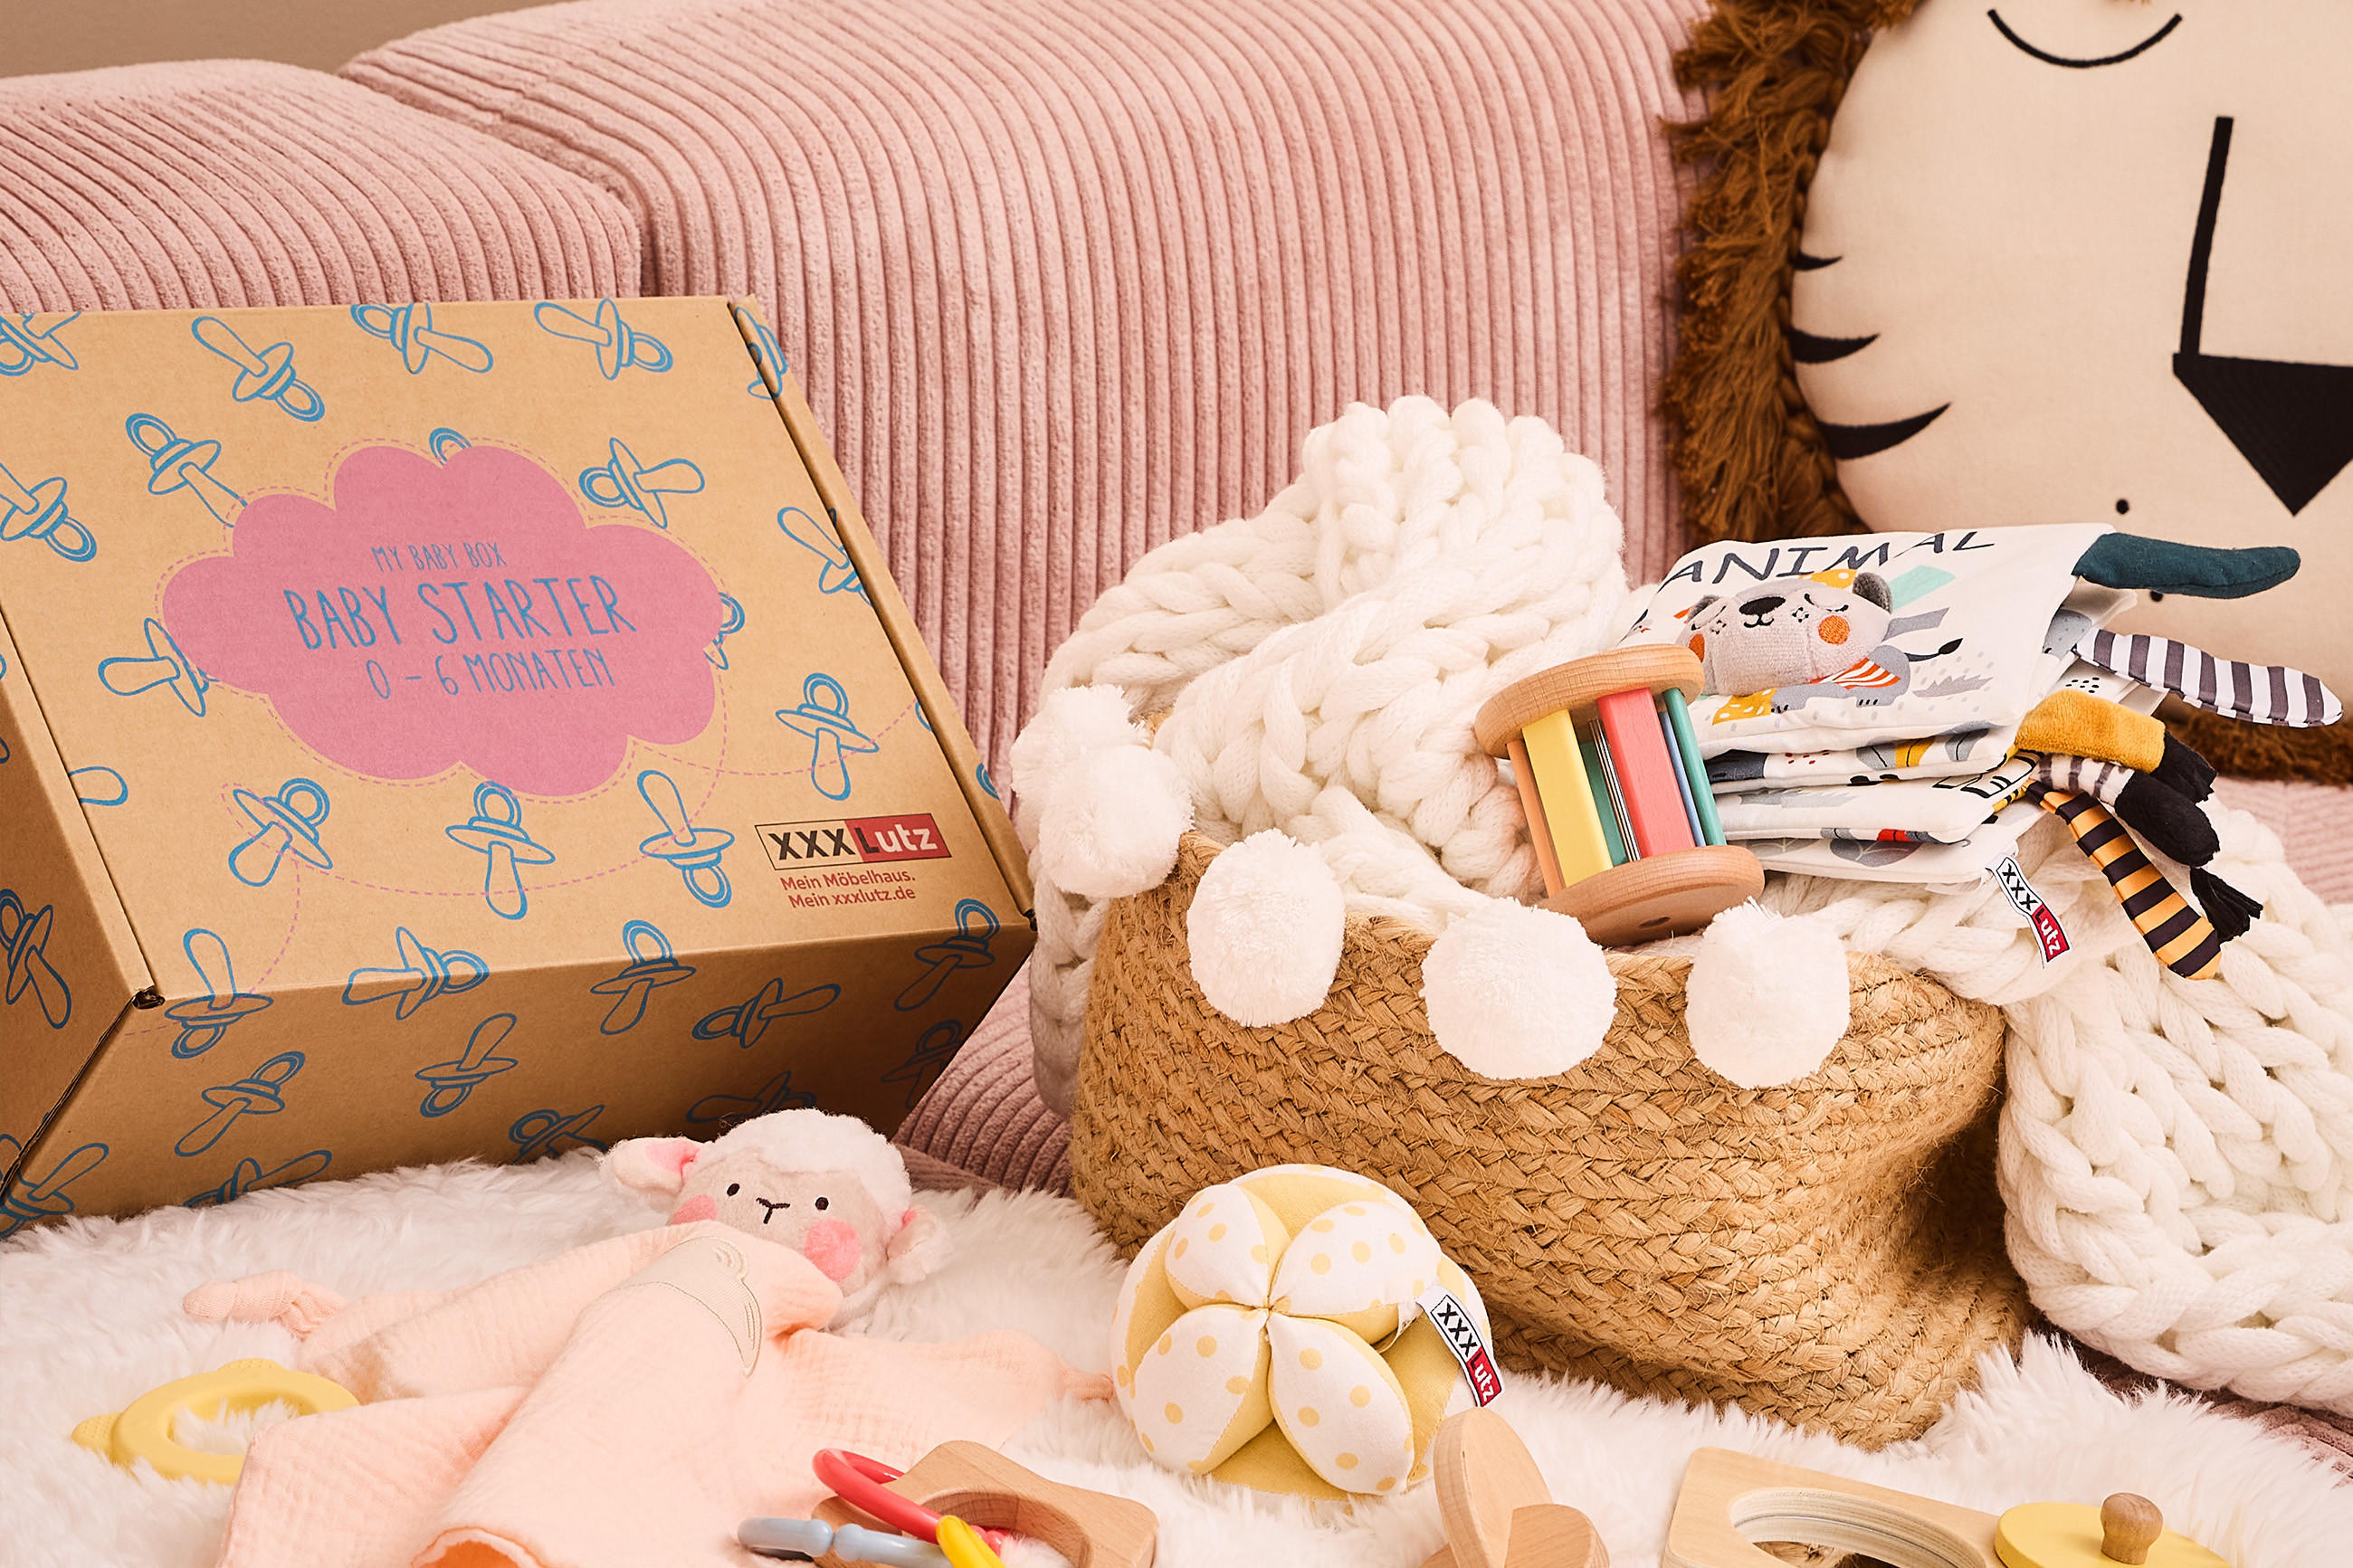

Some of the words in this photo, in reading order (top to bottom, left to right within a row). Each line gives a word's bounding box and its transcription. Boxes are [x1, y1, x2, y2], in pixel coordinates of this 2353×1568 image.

[370, 546, 405, 573] MY
[408, 543, 459, 571] BABY
[462, 541, 508, 568] BOX
[1657, 531, 1995, 594] ANIMAL
[283, 586, 402, 650] BABY
[417, 575, 637, 644] STARTER
[366, 660, 390, 699] 0
[435, 655, 459, 696] 6
[462, 648, 615, 693] MONATEN
[780, 873, 824, 891] Mein
[822, 870, 916, 889] Möbelhaus.
[788, 891, 833, 908] Mein
[834, 886, 916, 906] xxxlutz.de
